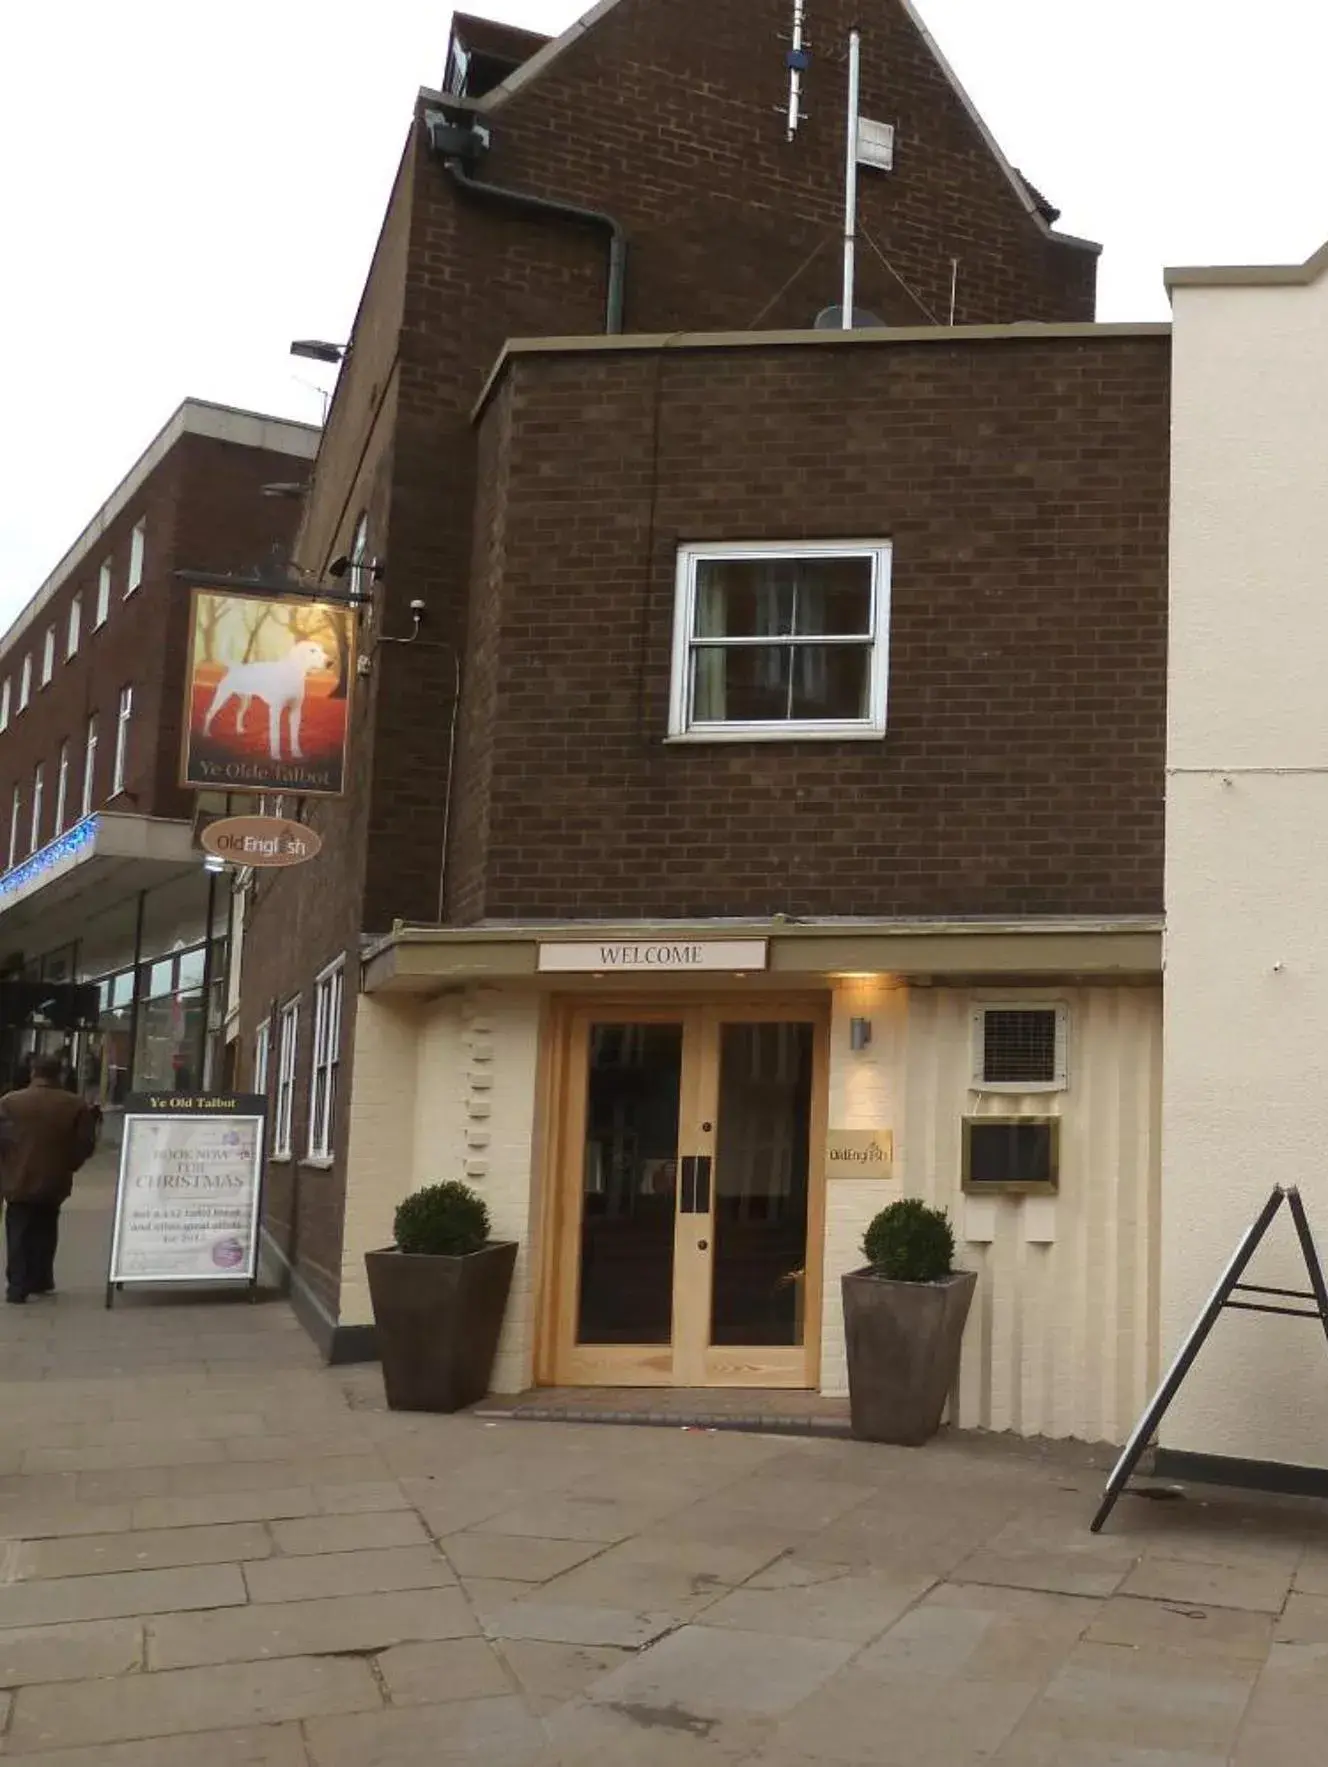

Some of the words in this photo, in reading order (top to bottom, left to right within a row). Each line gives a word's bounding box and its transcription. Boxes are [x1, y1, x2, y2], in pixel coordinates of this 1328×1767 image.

[600, 946, 704, 964] WELCOME
[150, 1097, 166, 1108] Ye
[170, 1097, 192, 1108] Old
[197, 1097, 236, 1109] Talbot
[136, 1174, 244, 1189] CHRISTMAS
